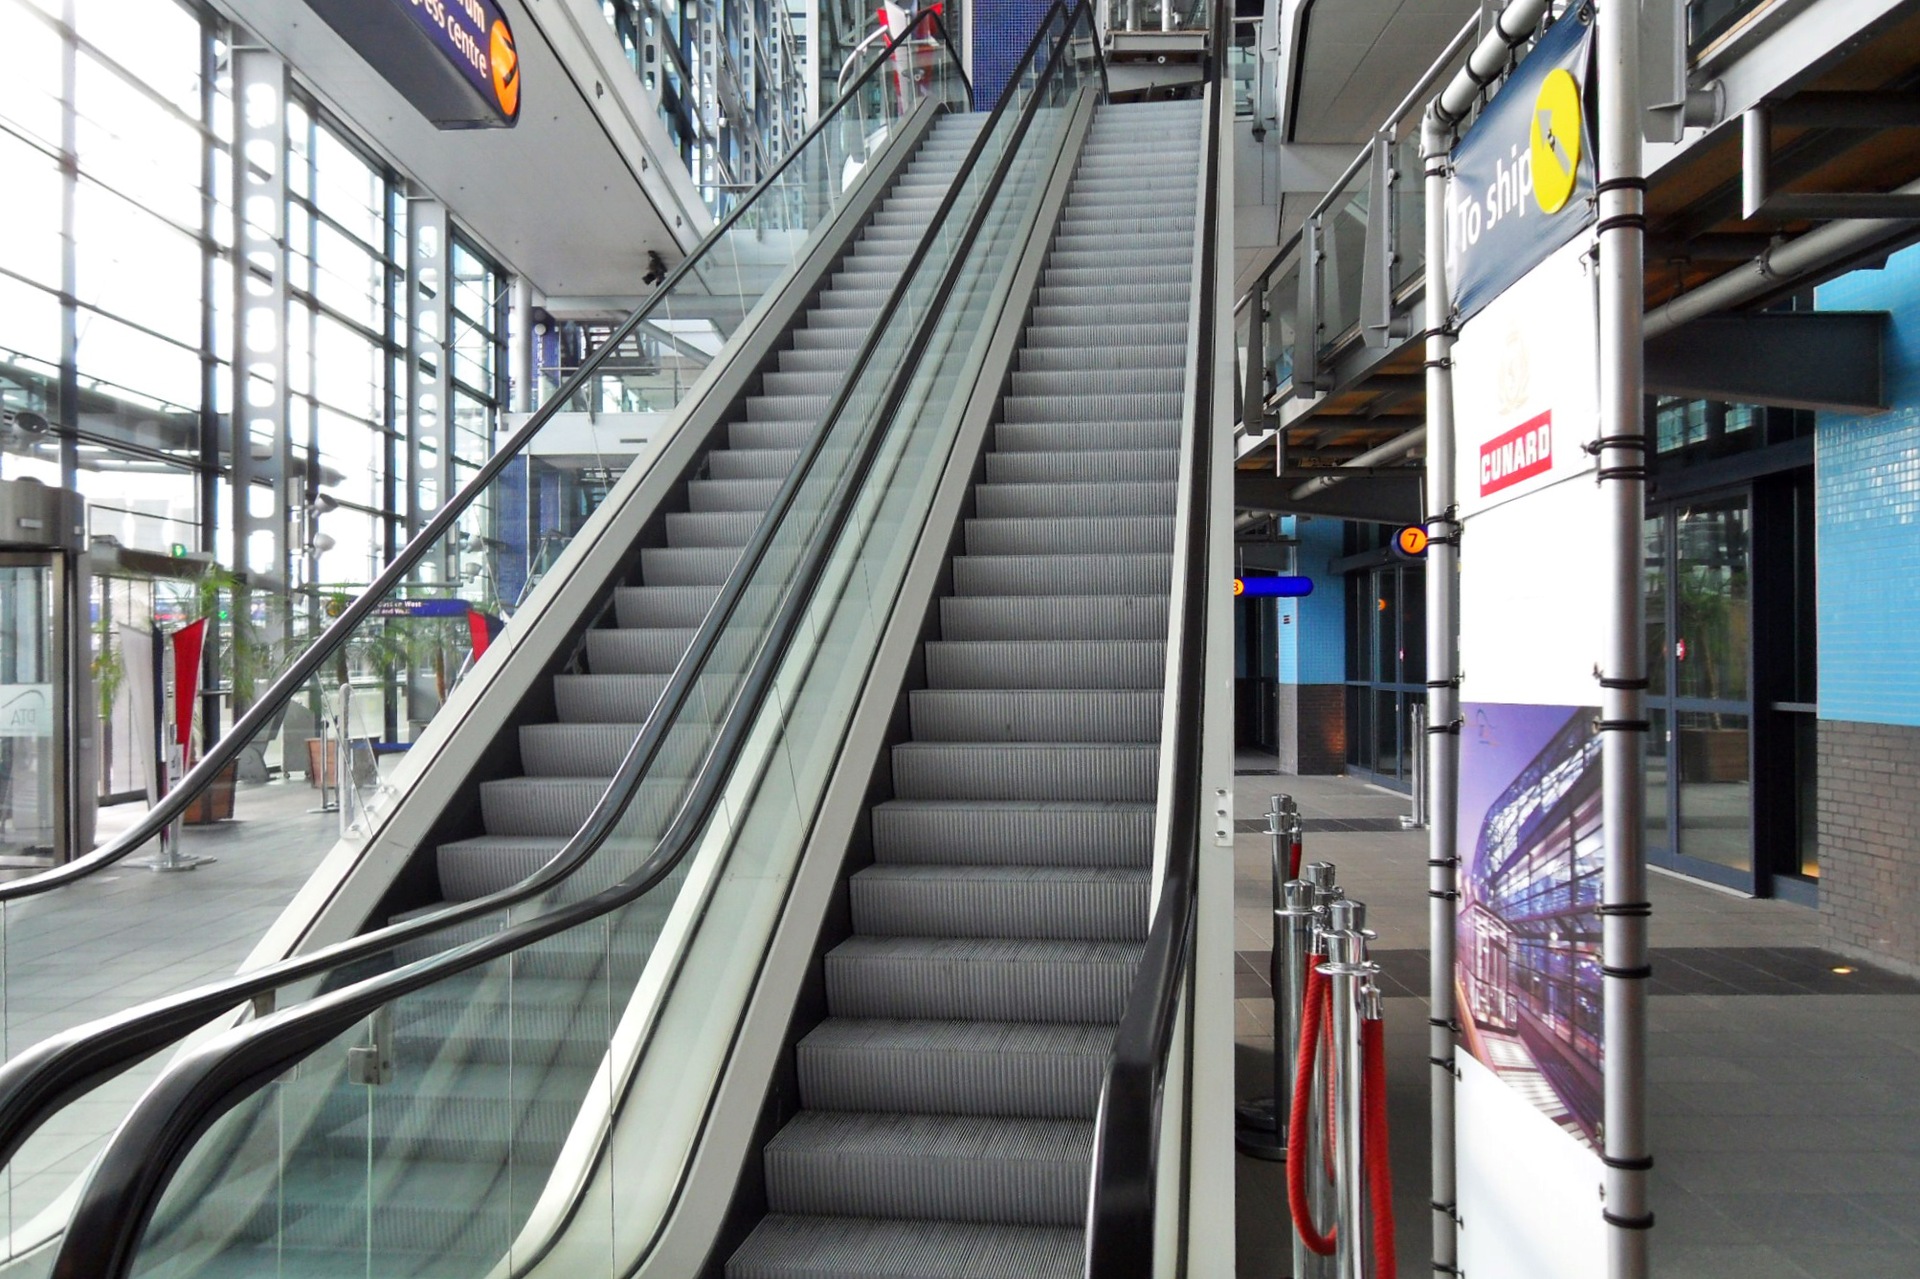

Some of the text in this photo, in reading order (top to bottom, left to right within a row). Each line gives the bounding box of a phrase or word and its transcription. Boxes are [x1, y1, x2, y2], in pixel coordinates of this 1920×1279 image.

[447, 15, 487, 79] Centre
[457, 0, 486, 33] um
[1458, 144, 1534, 253] To ship
[1481, 423, 1550, 486] CUNARD
[1408, 533, 1418, 548] 7
